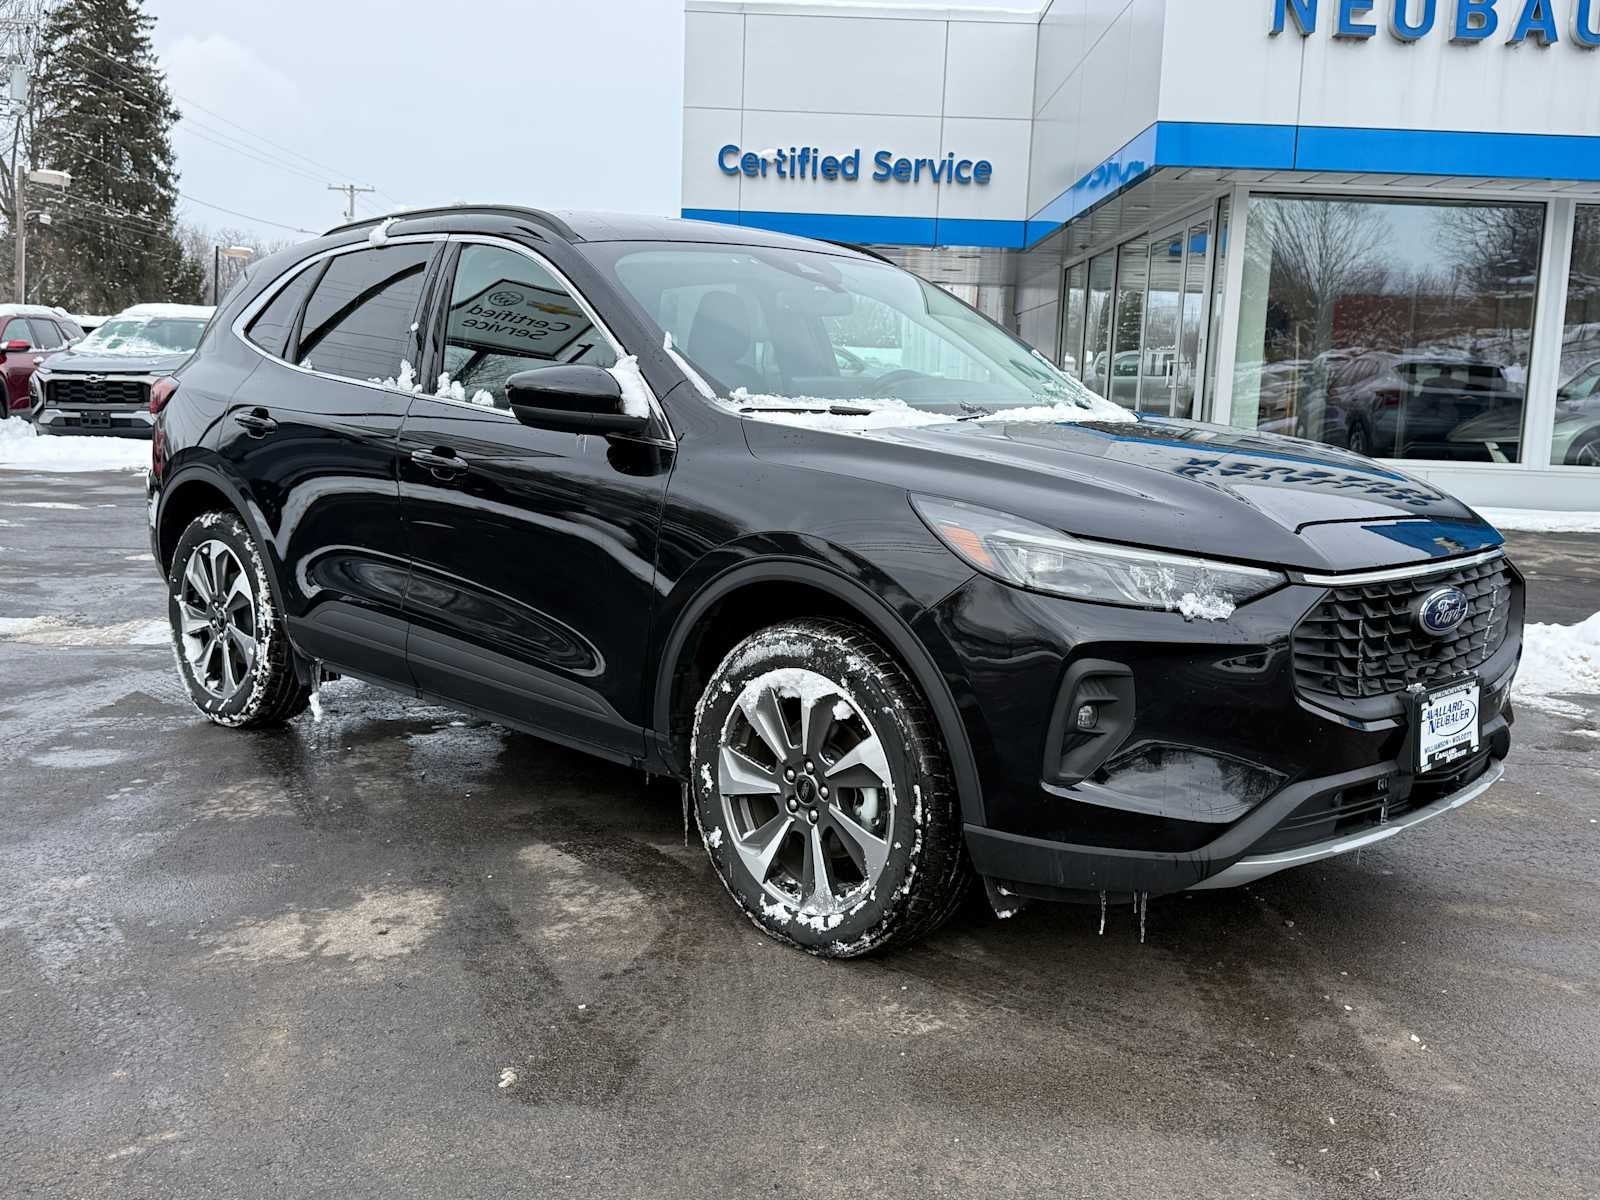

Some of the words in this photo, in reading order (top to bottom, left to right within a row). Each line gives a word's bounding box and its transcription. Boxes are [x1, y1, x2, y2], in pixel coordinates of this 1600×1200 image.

[718, 144, 861, 181] Certified
[872, 150, 993, 185] Service
[1435, 599, 1466, 625] Ford
